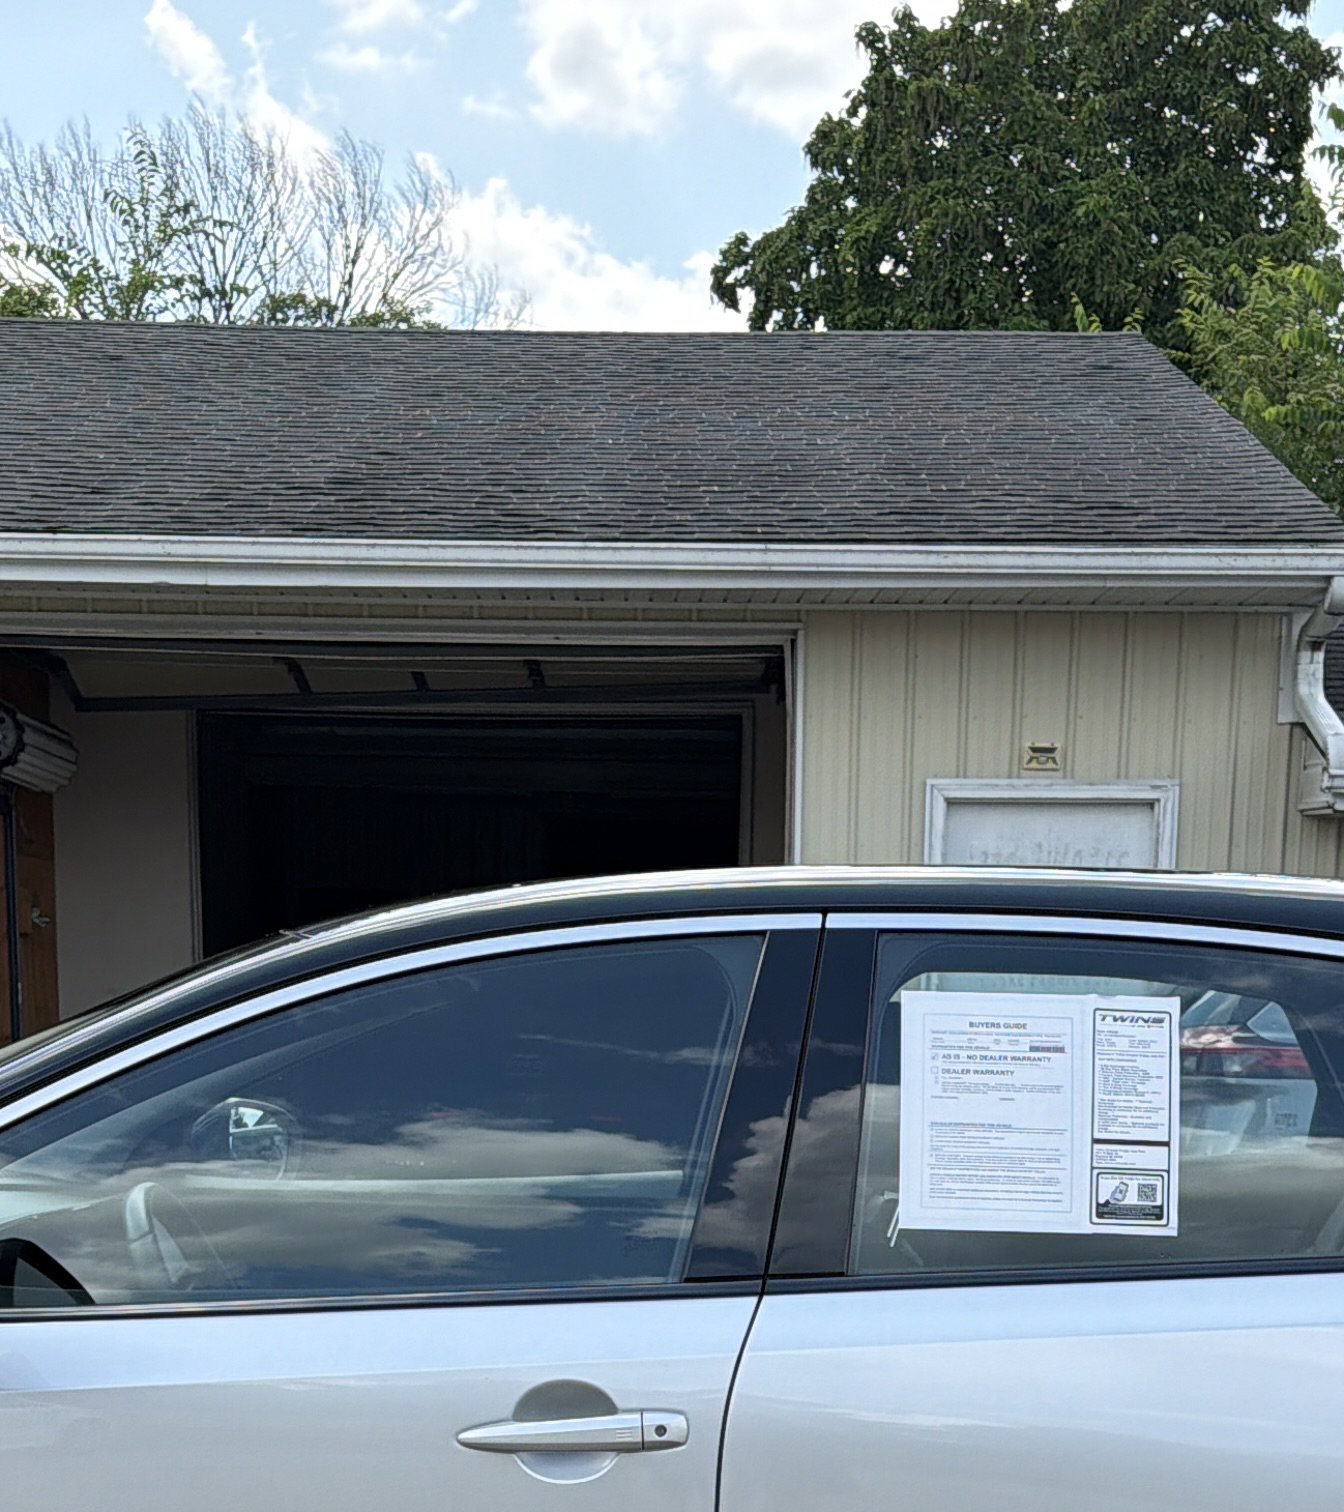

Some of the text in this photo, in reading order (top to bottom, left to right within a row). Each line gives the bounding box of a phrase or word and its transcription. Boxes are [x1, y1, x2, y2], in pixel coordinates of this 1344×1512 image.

[1099, 1013, 1166, 1024] TWINS
[969, 1021, 1028, 1030] BUYERS GUIDE
[954, 1053, 960, 1061] IS
[979, 1054, 1008, 1062] DEALER
[1010, 1055, 1052, 1063] WARRANTY
[973, 1068, 1015, 1077] WARRANTY
